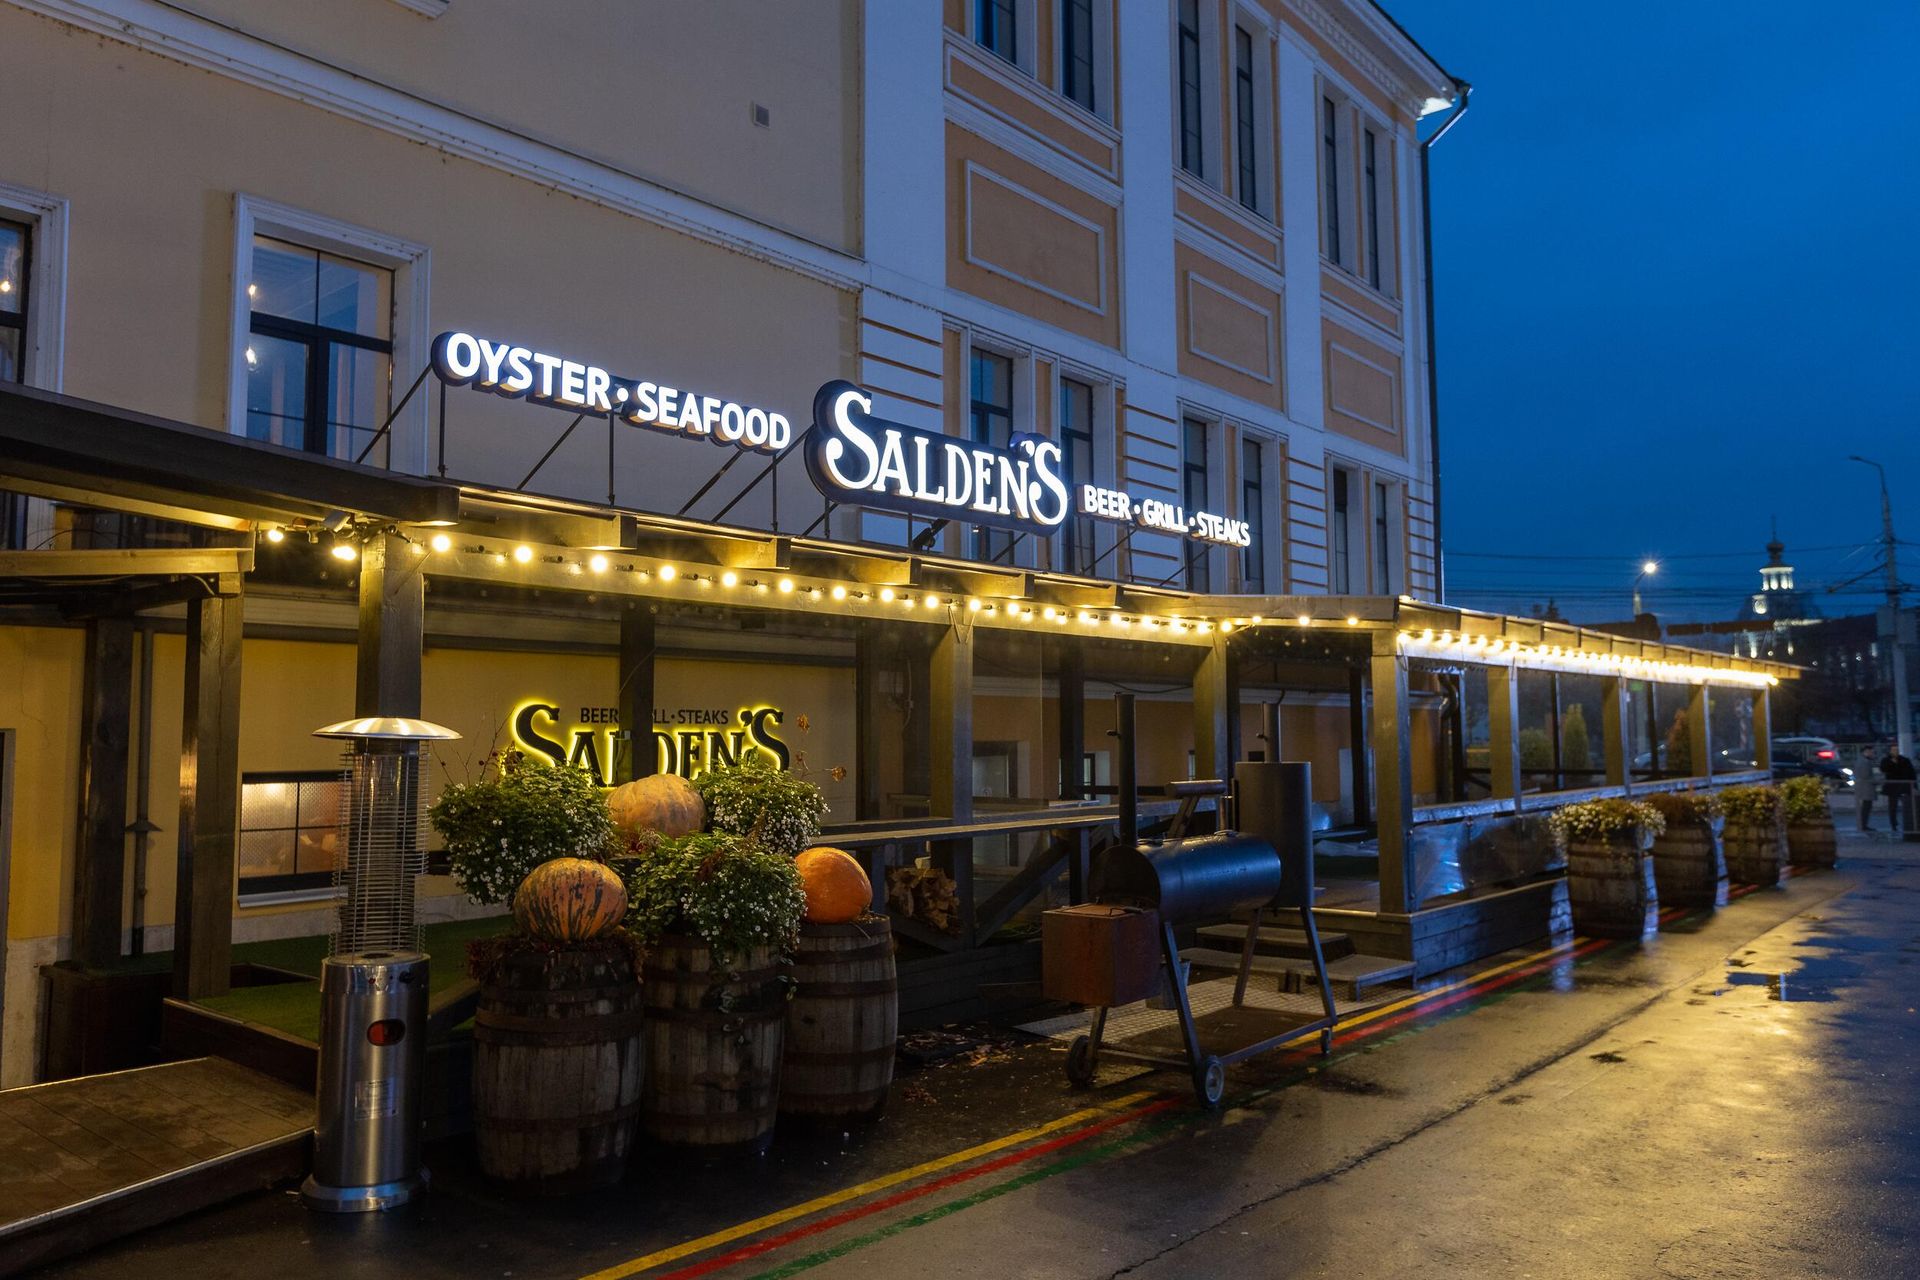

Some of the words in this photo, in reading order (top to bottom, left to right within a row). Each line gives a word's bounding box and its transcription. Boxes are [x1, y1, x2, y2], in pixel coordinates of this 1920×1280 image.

[446, 332, 612, 411] OYSTER
[634, 381, 791, 449] SEAFOOD
[825, 390, 1068, 526] SALDEN'S
[1083, 484, 1132, 520] BEER
[1143, 498, 1189, 533] GRILL
[1197, 511, 1251, 547] STEAKS
[580, 707, 619, 724] BEER
[677, 709, 729, 724] STEAKS
